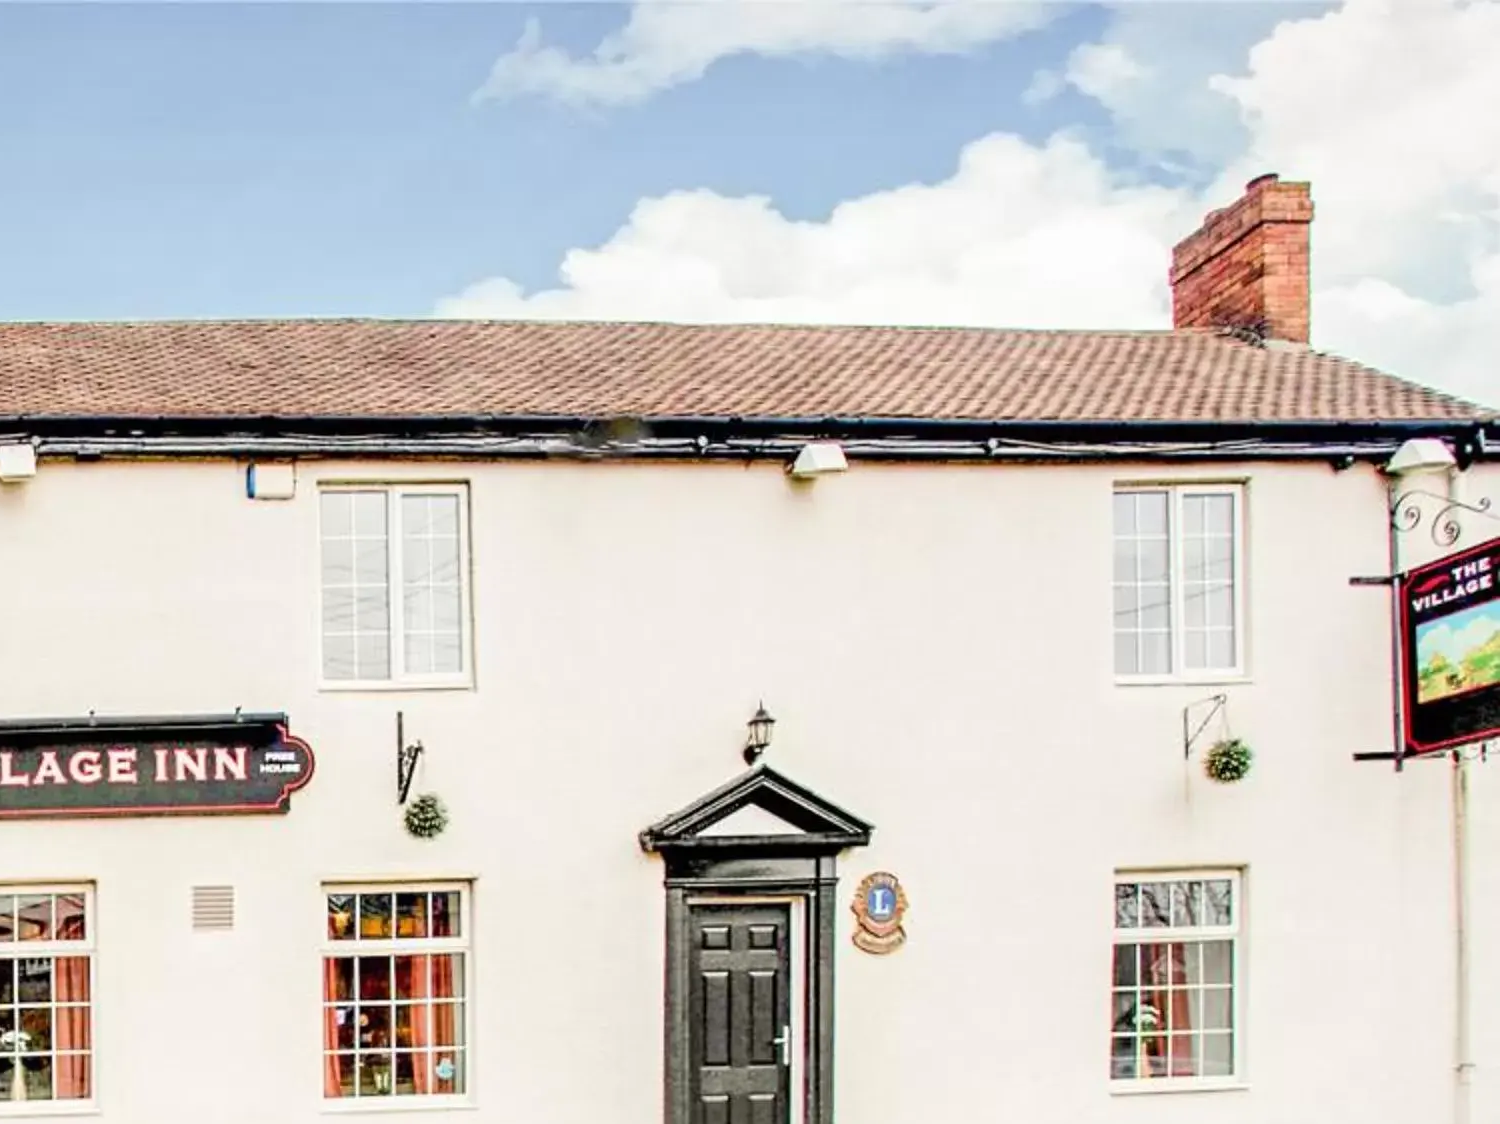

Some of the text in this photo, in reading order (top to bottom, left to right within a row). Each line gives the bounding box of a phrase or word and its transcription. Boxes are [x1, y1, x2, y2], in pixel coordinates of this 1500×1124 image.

[1451, 557, 1491, 581] THE
[1412, 574, 1492, 612] VILLAGE
[154, 747, 248, 782] INN
[259, 763, 301, 773] HOUSE
